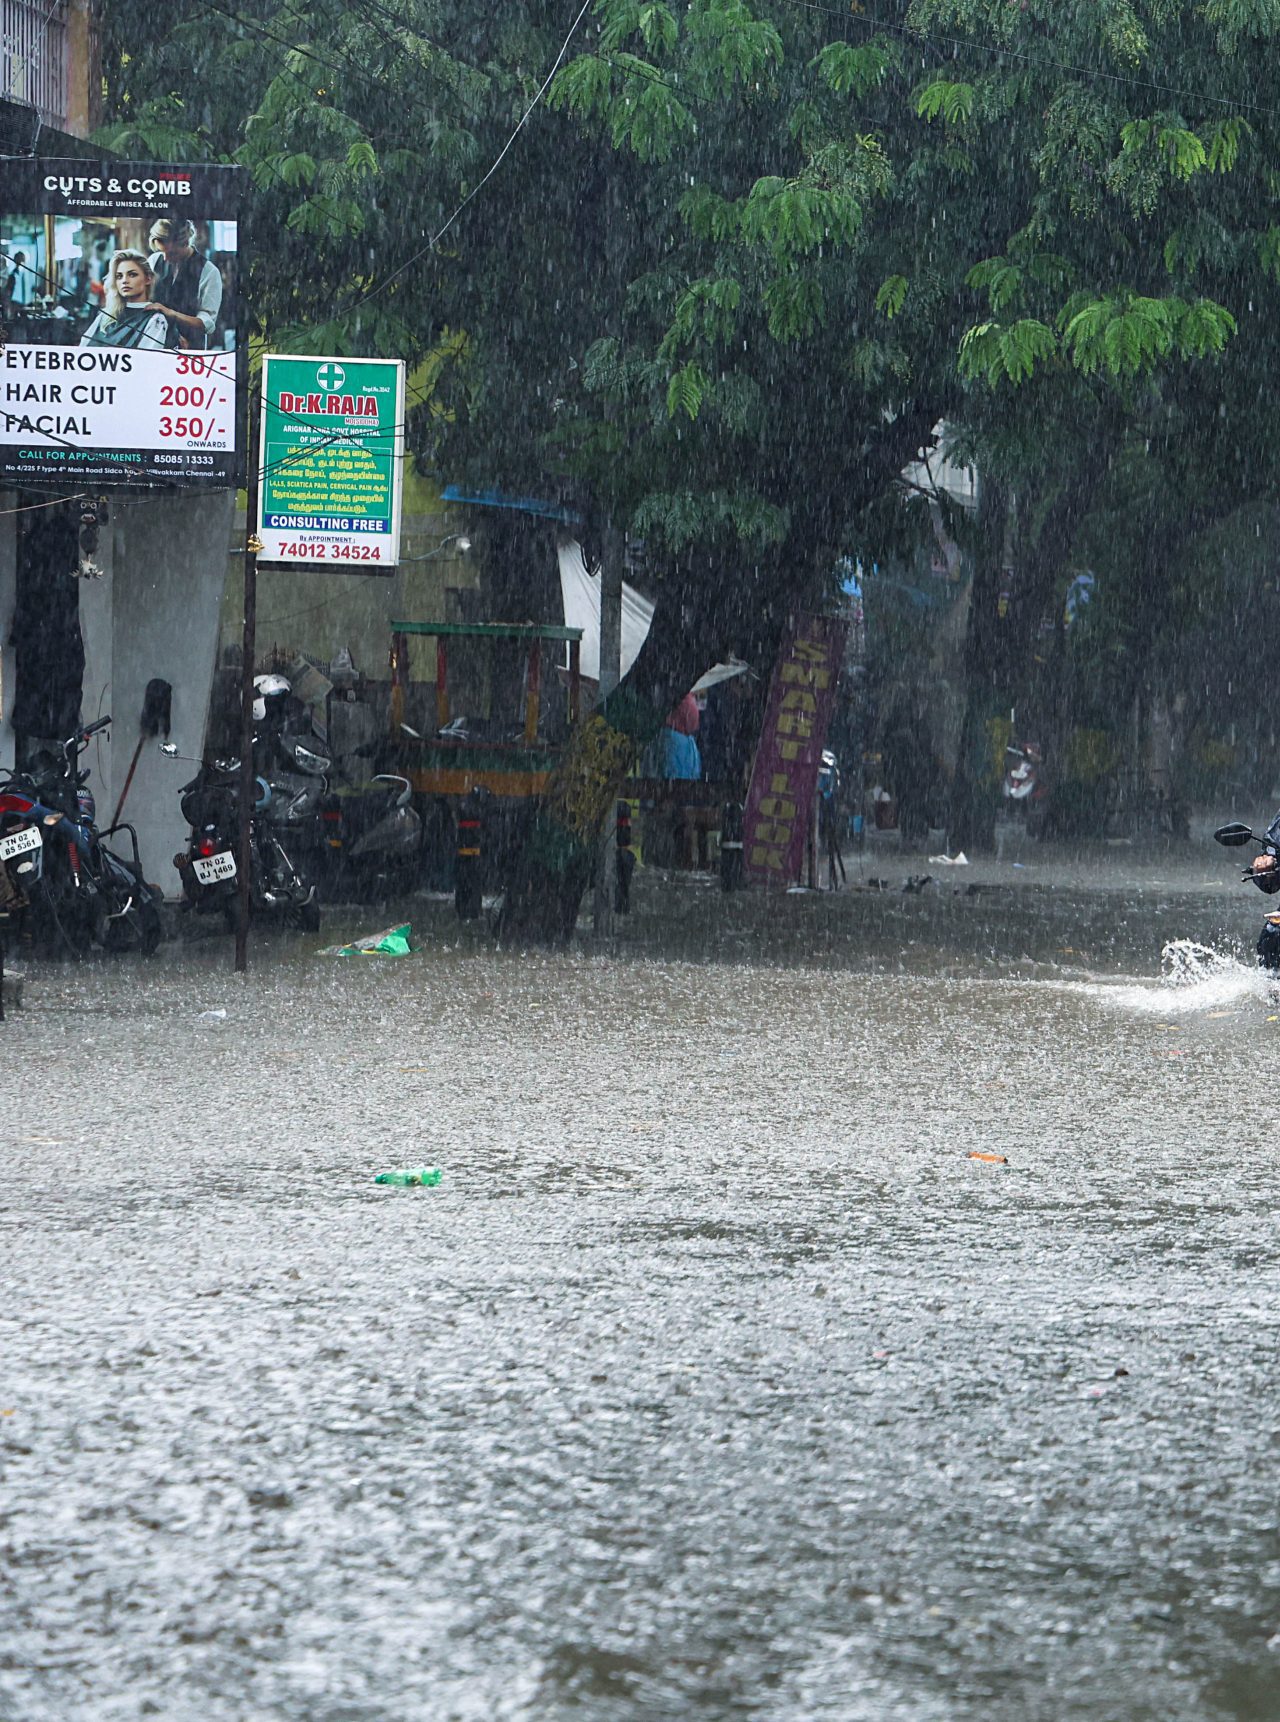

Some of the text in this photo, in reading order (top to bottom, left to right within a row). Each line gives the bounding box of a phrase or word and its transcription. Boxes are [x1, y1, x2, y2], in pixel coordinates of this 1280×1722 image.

[44, 176, 191, 200] CUTS & COMB
[67, 199, 113, 207] AFFORDABLE
[6, 350, 133, 373] EYEBROWS
[6, 383, 227, 410] HAIR CUT 200/-
[279, 392, 379, 417] Dr.K.RAJA
[5, 414, 226, 441] FACIAL 350/-
[283, 425, 311, 433] ARIGNAR
[187, 440, 226, 448] ONWARDS
[19, 450, 44, 459] CALL
[46, 451, 66, 460] FOR
[154, 455, 183, 463] 85085
[186, 456, 214, 464] 13333
[186, 469, 214, 477] Chennai
[287, 480, 313, 488] SCIATICA
[330, 482, 357, 490] CERVICAL
[271, 515, 384, 531] CONSULTING FREE
[278, 542, 381, 560] 74012 34524
[6, 834, 28, 847] TN 02
[5, 846, 16, 855] BS
[214, 857, 225, 865] 02
[200, 864, 233, 880] BJ 1469
